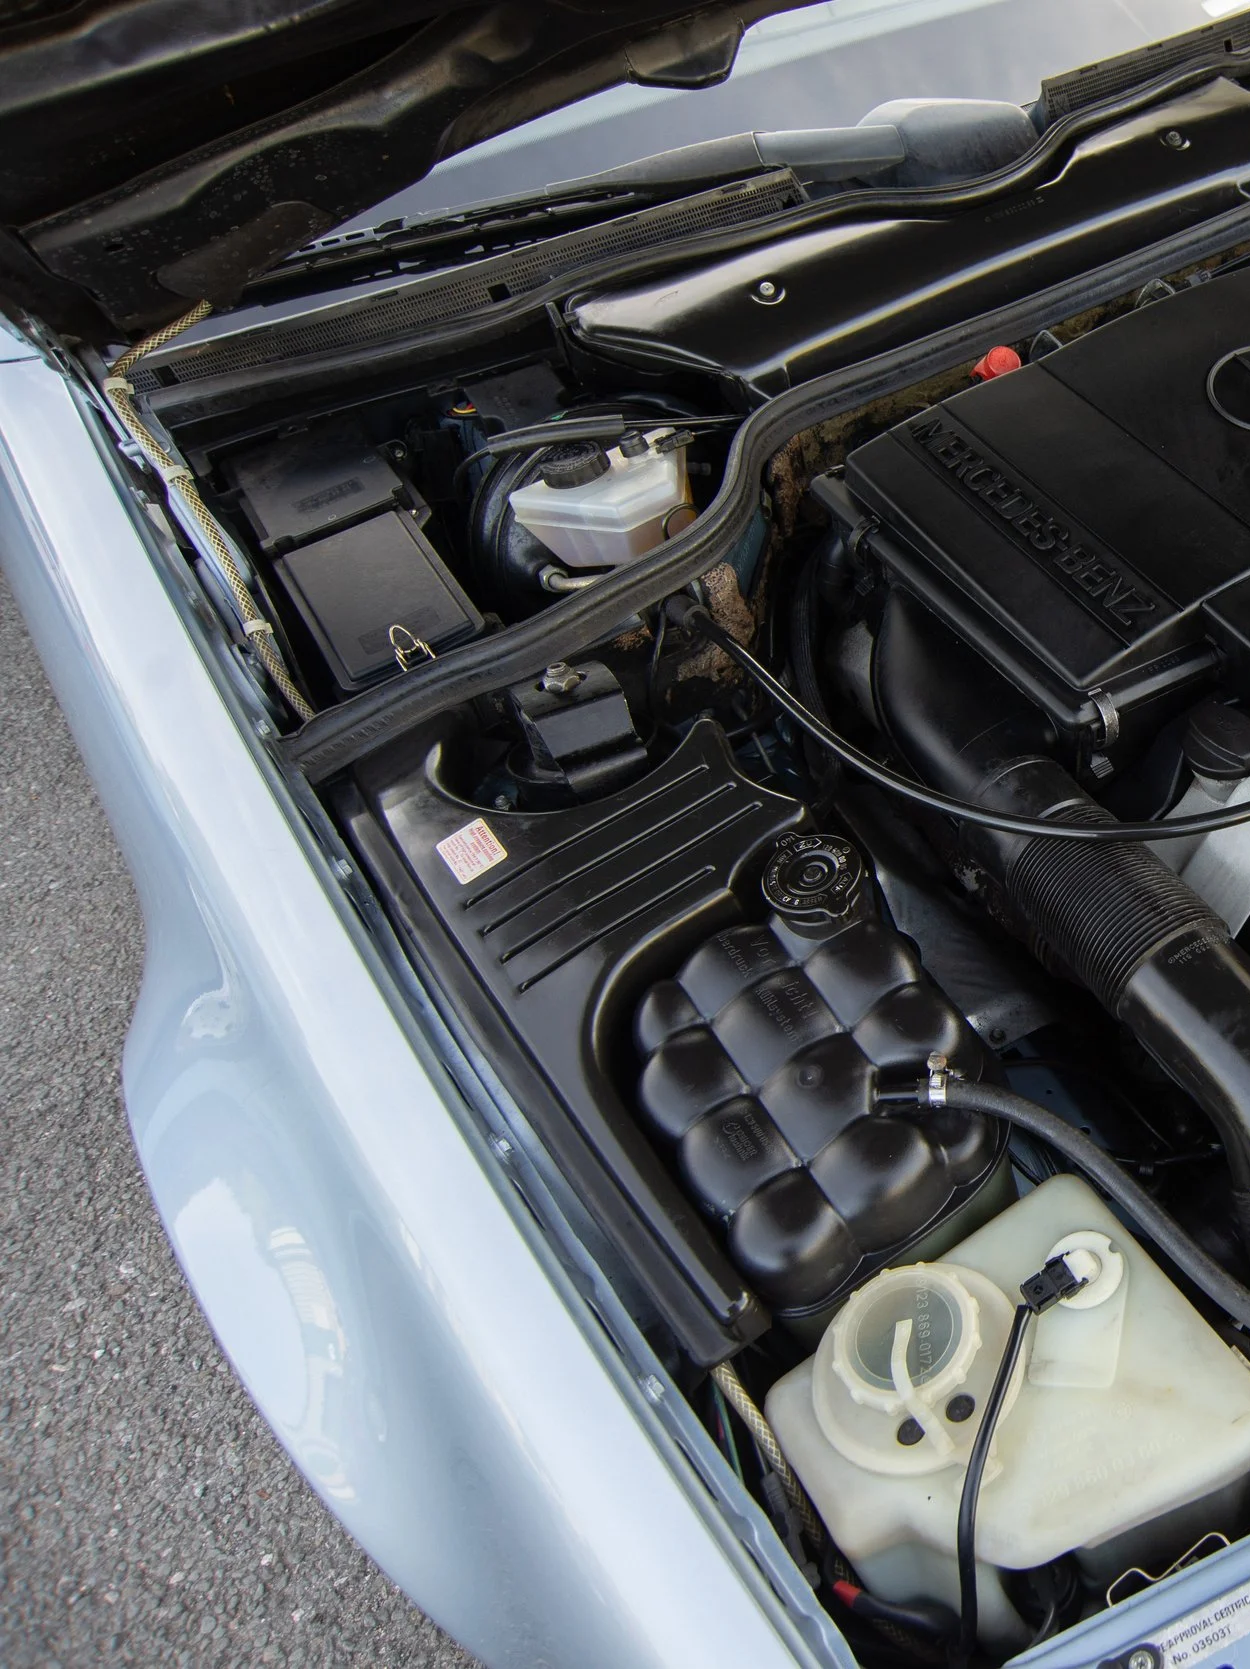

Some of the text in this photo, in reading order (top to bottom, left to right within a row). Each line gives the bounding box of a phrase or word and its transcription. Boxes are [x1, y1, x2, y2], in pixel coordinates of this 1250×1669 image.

[910, 417, 1156, 627] MERCEDES-BENZ
[476, 825, 501, 857] Attention!
[1166, 1616, 1213, 1649] APPROVAL
